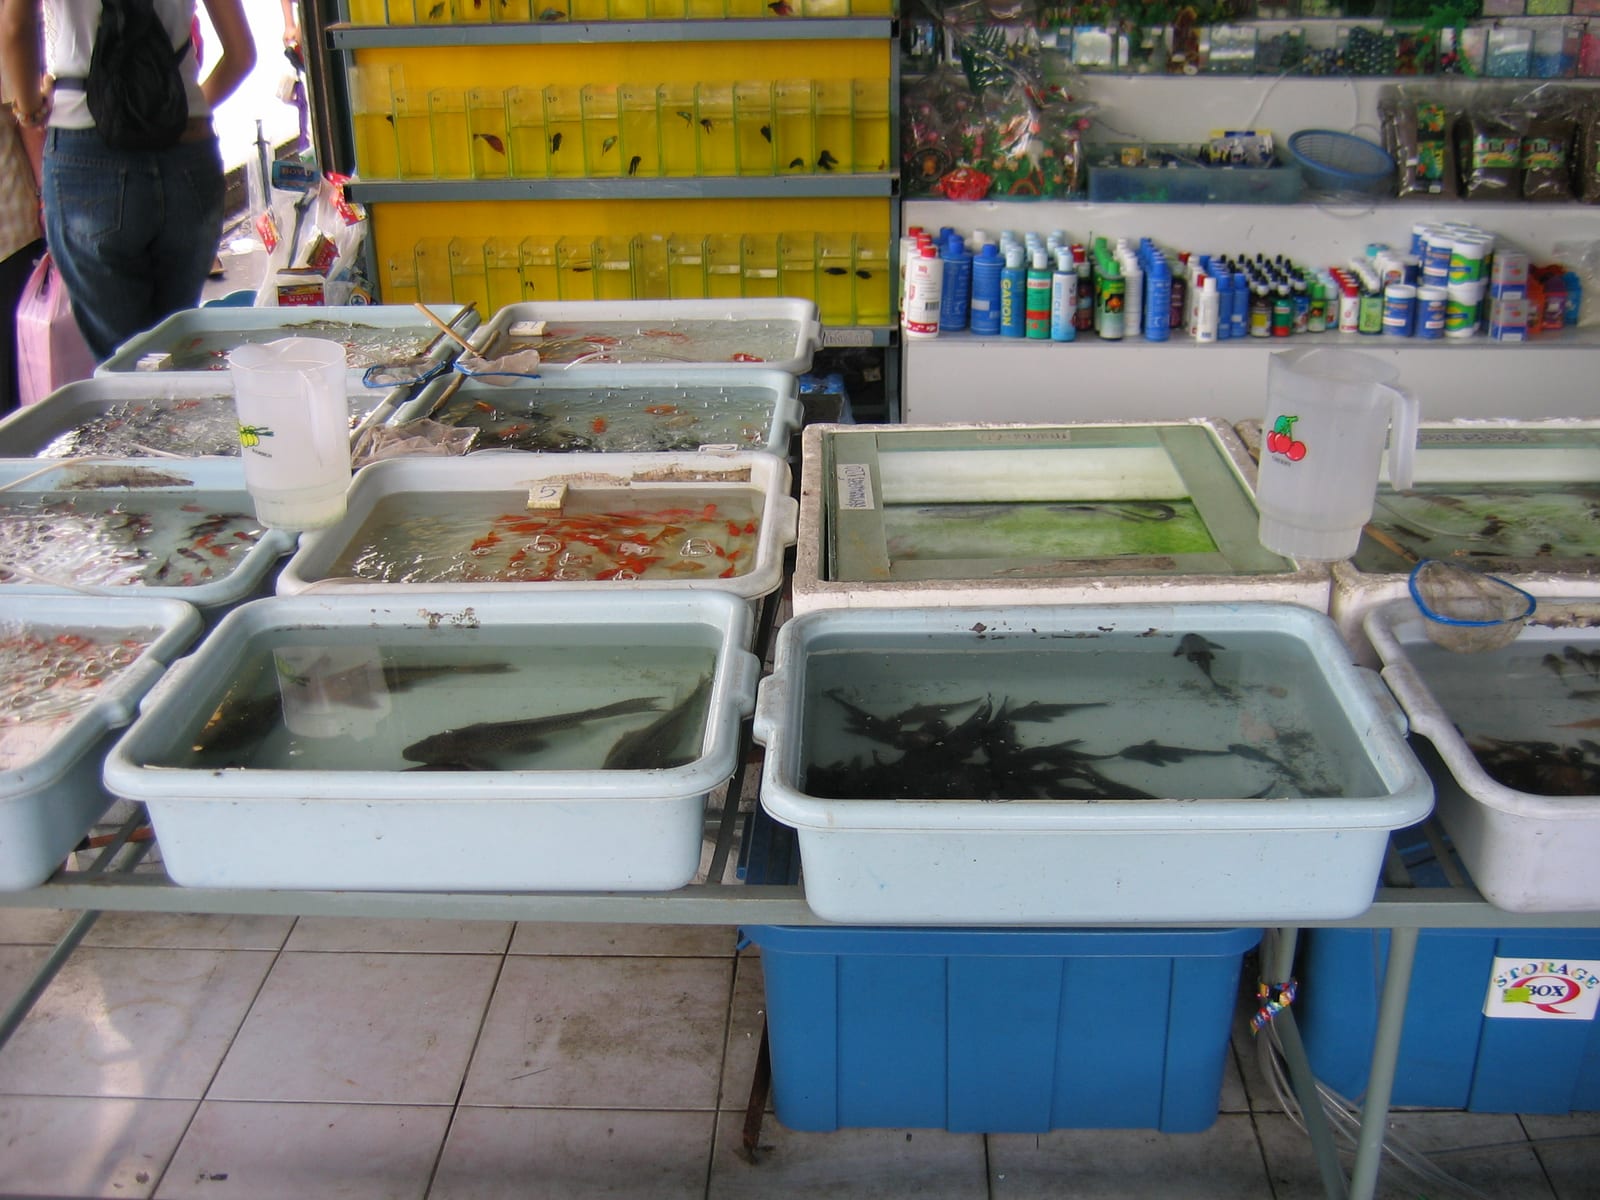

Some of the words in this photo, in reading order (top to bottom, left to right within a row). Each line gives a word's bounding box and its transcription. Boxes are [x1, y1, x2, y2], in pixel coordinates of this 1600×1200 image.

[1002, 278, 1012, 327] GARON
[540, 485, 560, 499] 5
[1494, 960, 1600, 989] STORAGE
[1526, 984, 1567, 998] BOX
